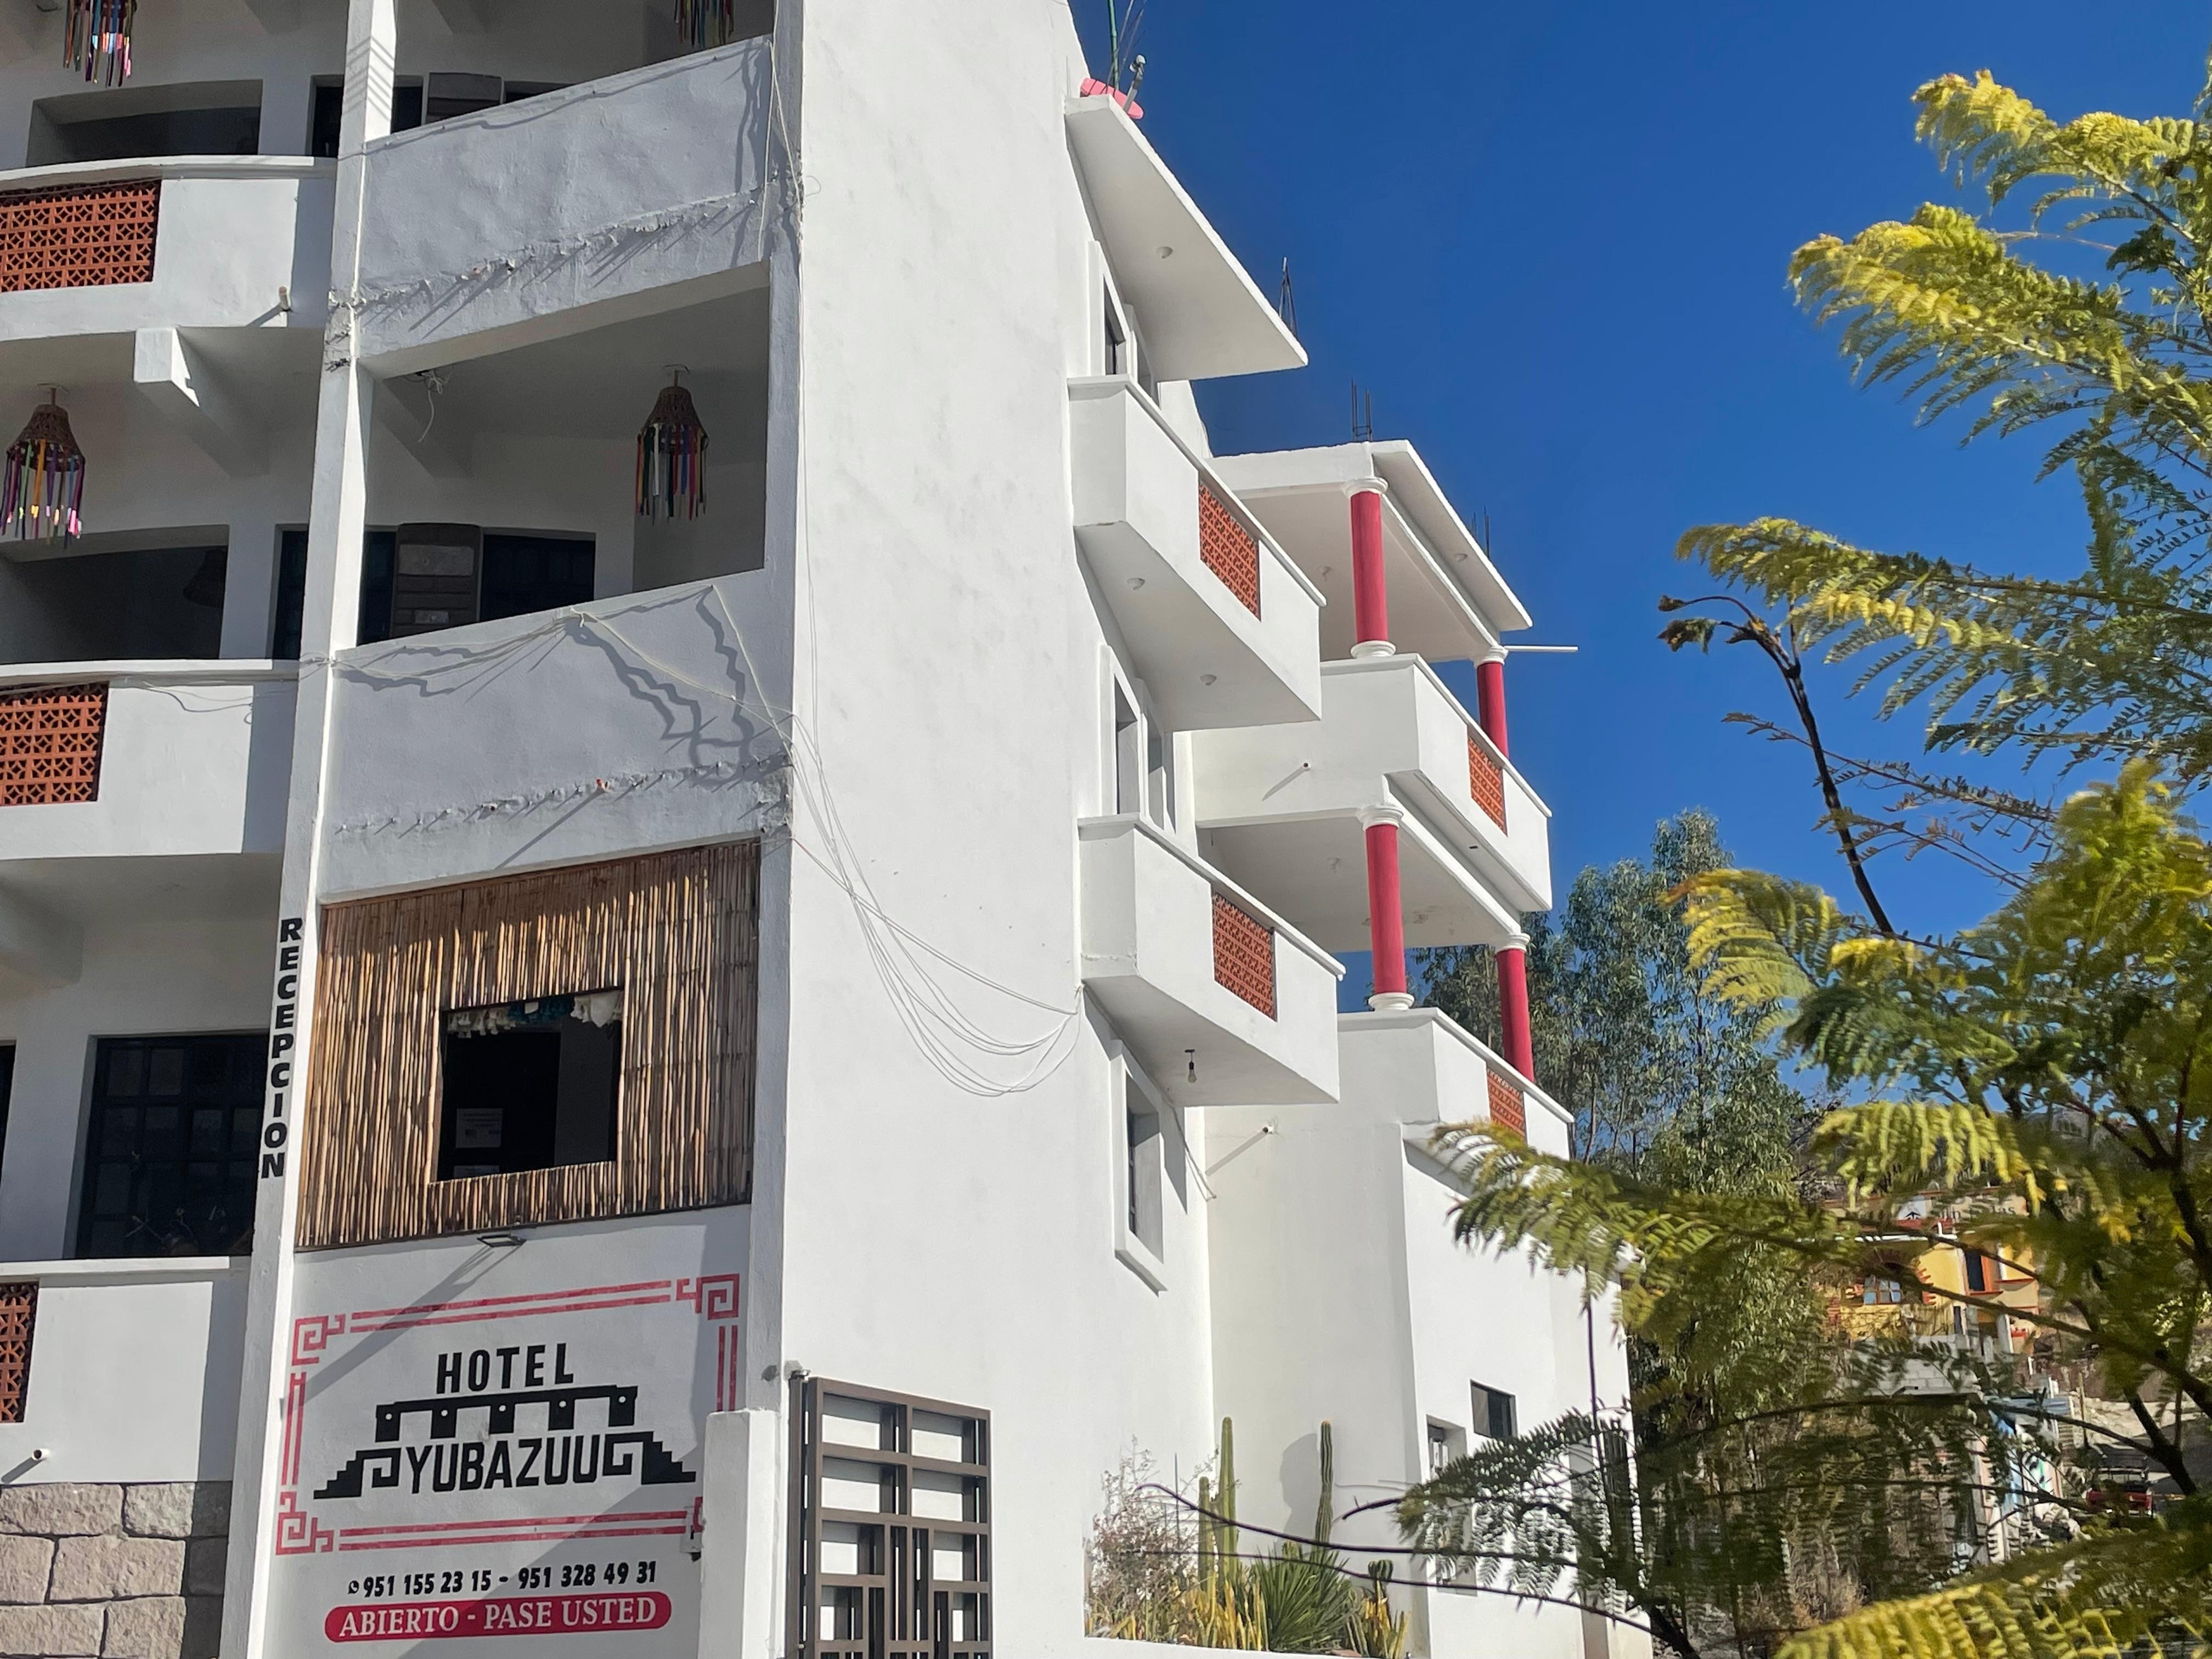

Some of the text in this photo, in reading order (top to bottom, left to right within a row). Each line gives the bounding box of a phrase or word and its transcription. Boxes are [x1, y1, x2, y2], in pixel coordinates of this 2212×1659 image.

[261, 917, 303, 1178] RECEPCION
[437, 1342, 573, 1394] HOTEL
[405, 1435, 600, 1494] YUBAZUU
[363, 1575, 395, 1598] 951
[404, 1573, 435, 1595] 155
[440, 1571, 463, 1593] 23
[472, 1570, 492, 1592] 15
[518, 1567, 551, 1589] 951
[561, 1564, 596, 1587] 328
[603, 1562, 629, 1584] 49
[636, 1561, 656, 1584] 31
[339, 1606, 459, 1637] ABIERTO
[484, 1602, 552, 1629] PASE
[561, 1597, 657, 1626] USTED
